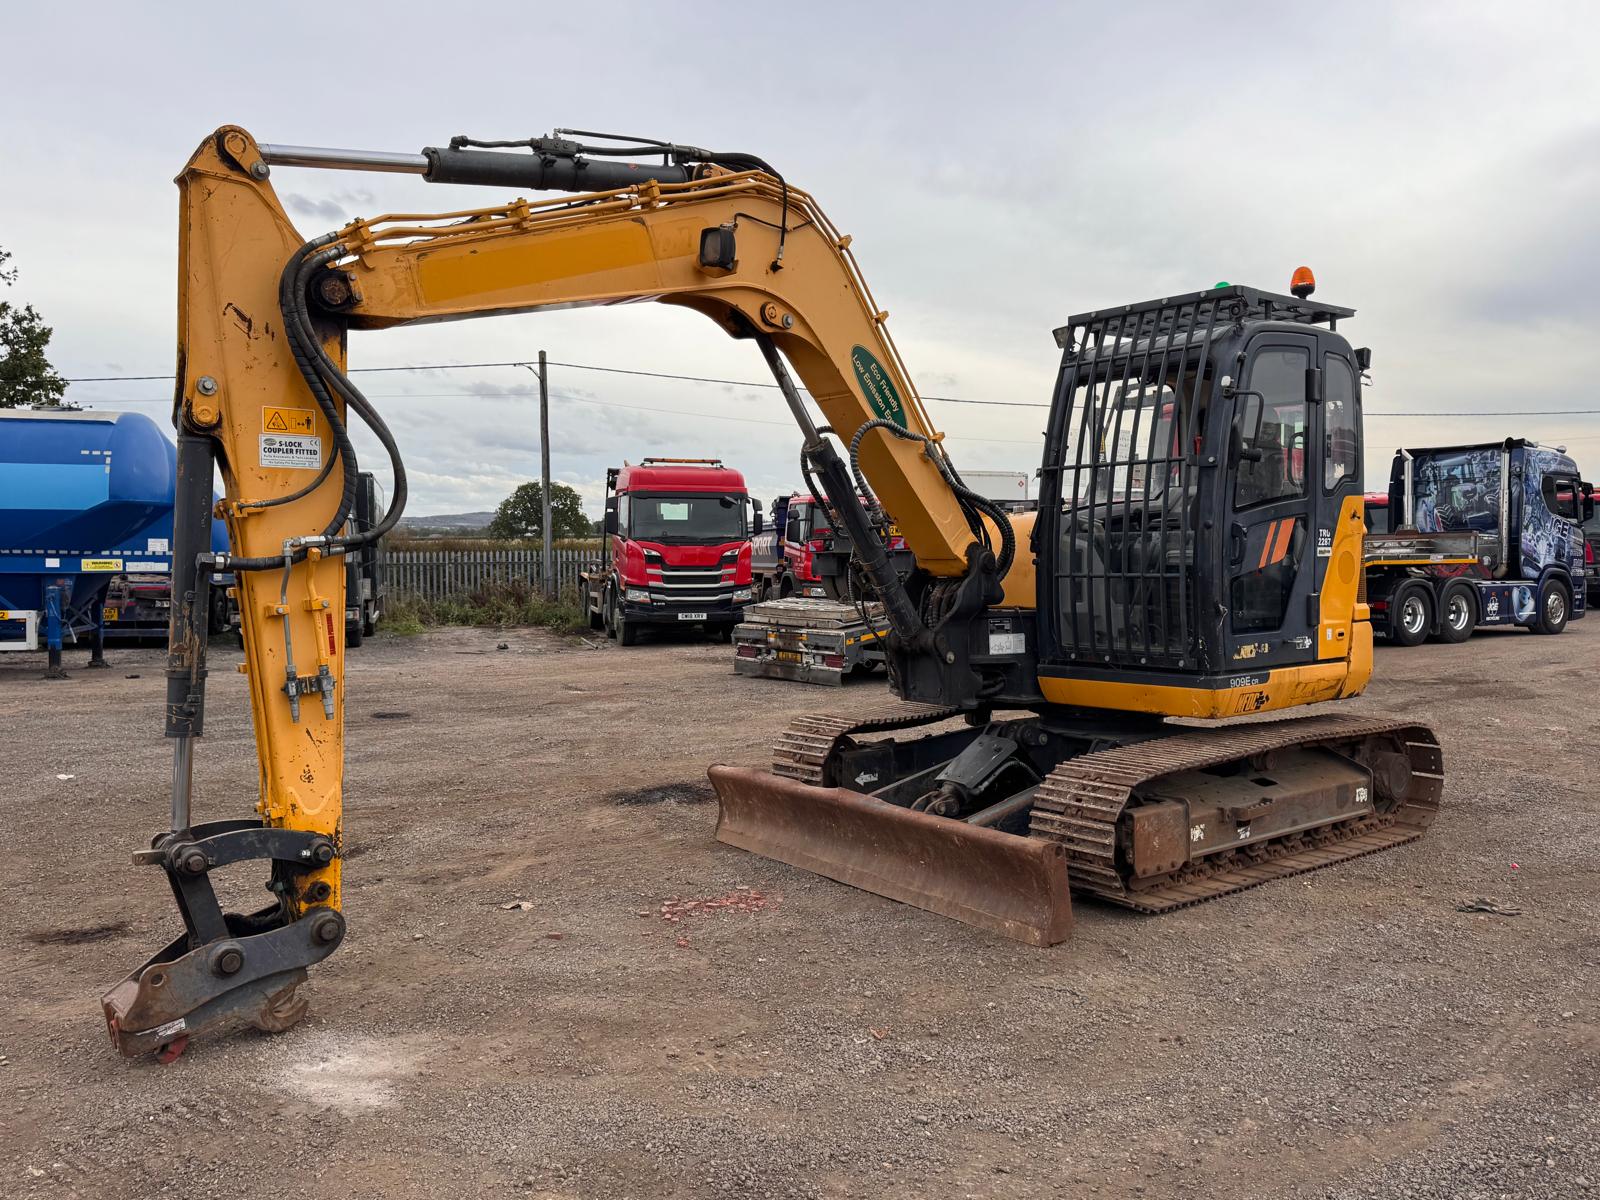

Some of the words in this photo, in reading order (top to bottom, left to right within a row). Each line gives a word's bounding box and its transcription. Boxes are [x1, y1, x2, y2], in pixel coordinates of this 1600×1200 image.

[853, 354, 864, 373] Low
[864, 374, 886, 410] Emission
[871, 363, 881, 380] Eco
[880, 380, 899, 412] Friendly
[1546, 516, 1570, 539] JGE
[1319, 538, 1331, 546] 2287
[1230, 677, 1251, 688] 909E
